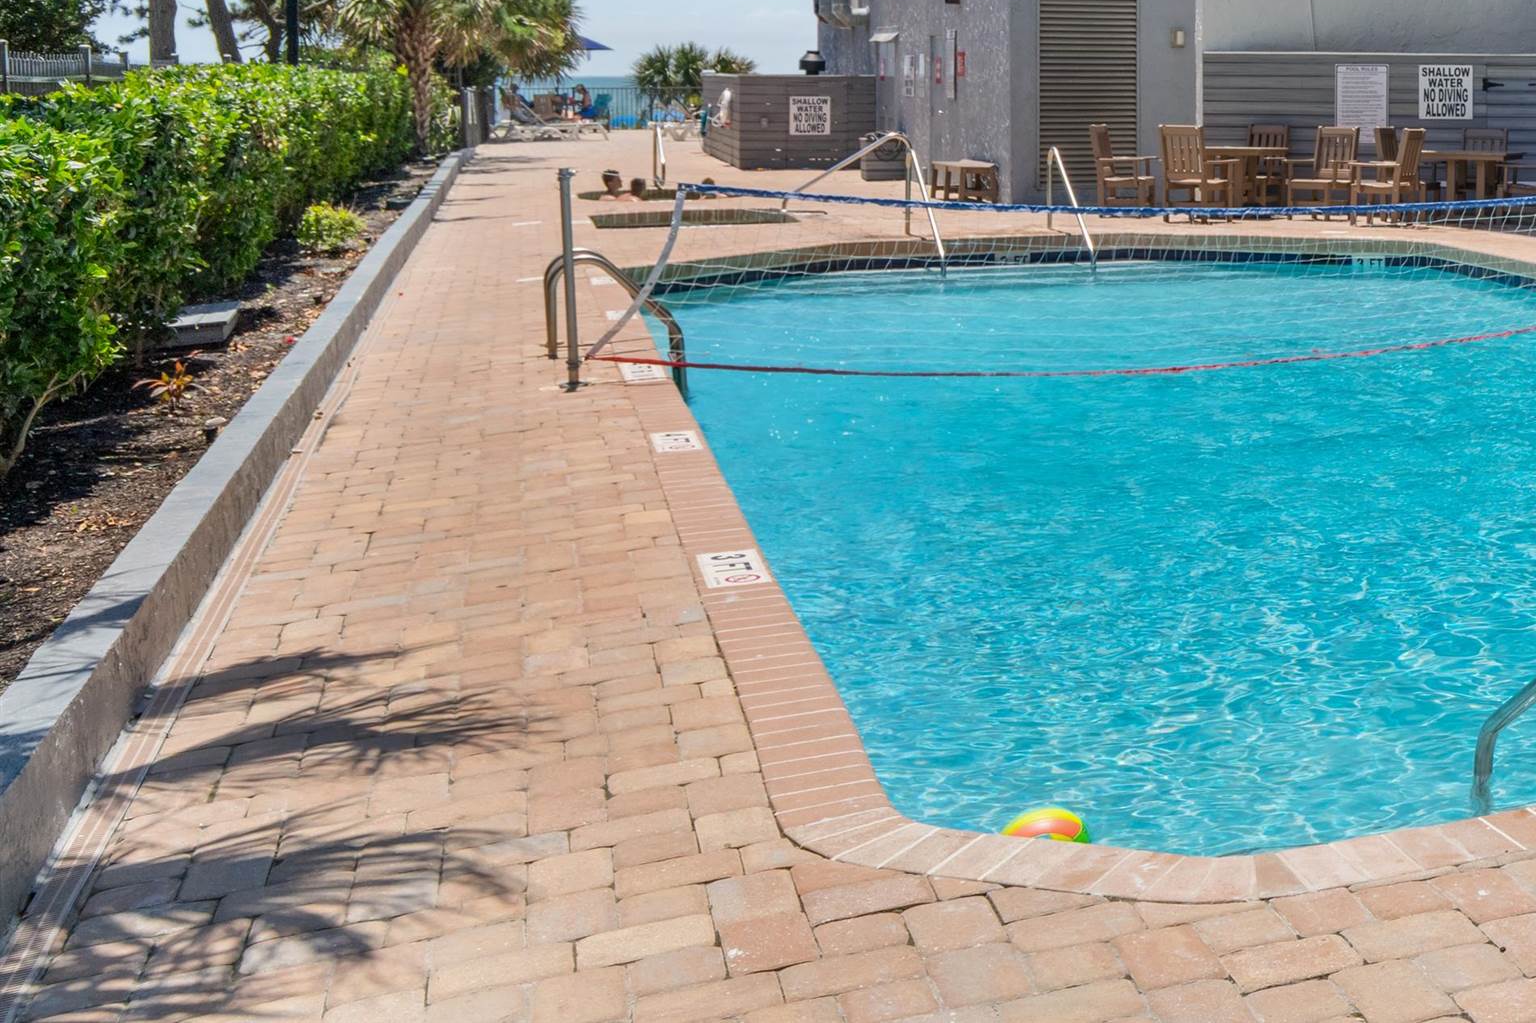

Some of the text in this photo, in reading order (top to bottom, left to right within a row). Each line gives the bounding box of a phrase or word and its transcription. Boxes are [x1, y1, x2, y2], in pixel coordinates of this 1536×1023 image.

[1422, 67, 1470, 77] SHALLOW
[1428, 78, 1463, 87] WATER
[1424, 88, 1468, 102] NO DIVING
[1425, 103, 1466, 117] ALLOWED
[793, 112, 827, 123] NO DIVING
[795, 123, 826, 133] ALLOWED
[712, 561, 752, 573] FT
